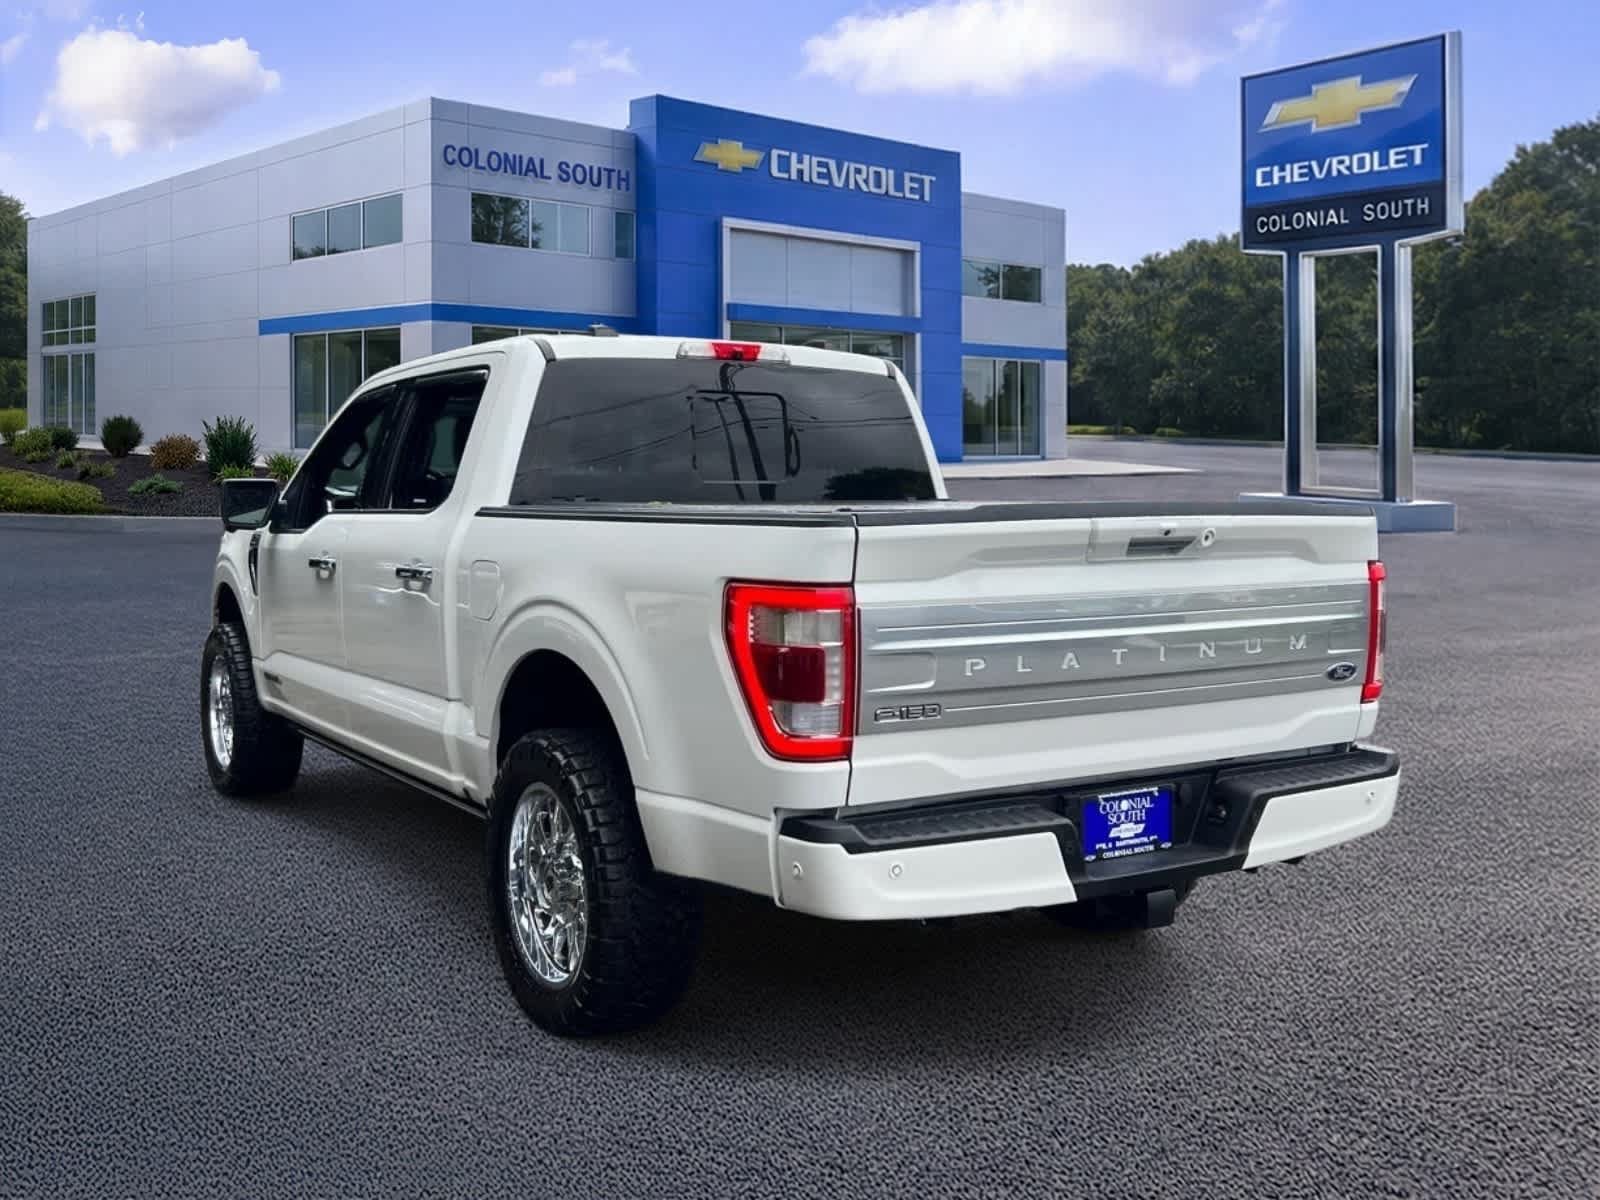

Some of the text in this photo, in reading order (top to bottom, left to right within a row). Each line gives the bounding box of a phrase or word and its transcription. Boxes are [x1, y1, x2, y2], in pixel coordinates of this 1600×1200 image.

[443, 144, 630, 192] COLONIAL SOUTH
[769, 148, 937, 203] CHEVROLET
[1255, 143, 1429, 187] CHEVROLET
[1256, 197, 1430, 234] COLONIAL SOUTH
[964, 634, 1308, 676] PLATINUM
[1099, 796, 1154, 815] COLONIAL
[1107, 809, 1146, 825] SOUTH
